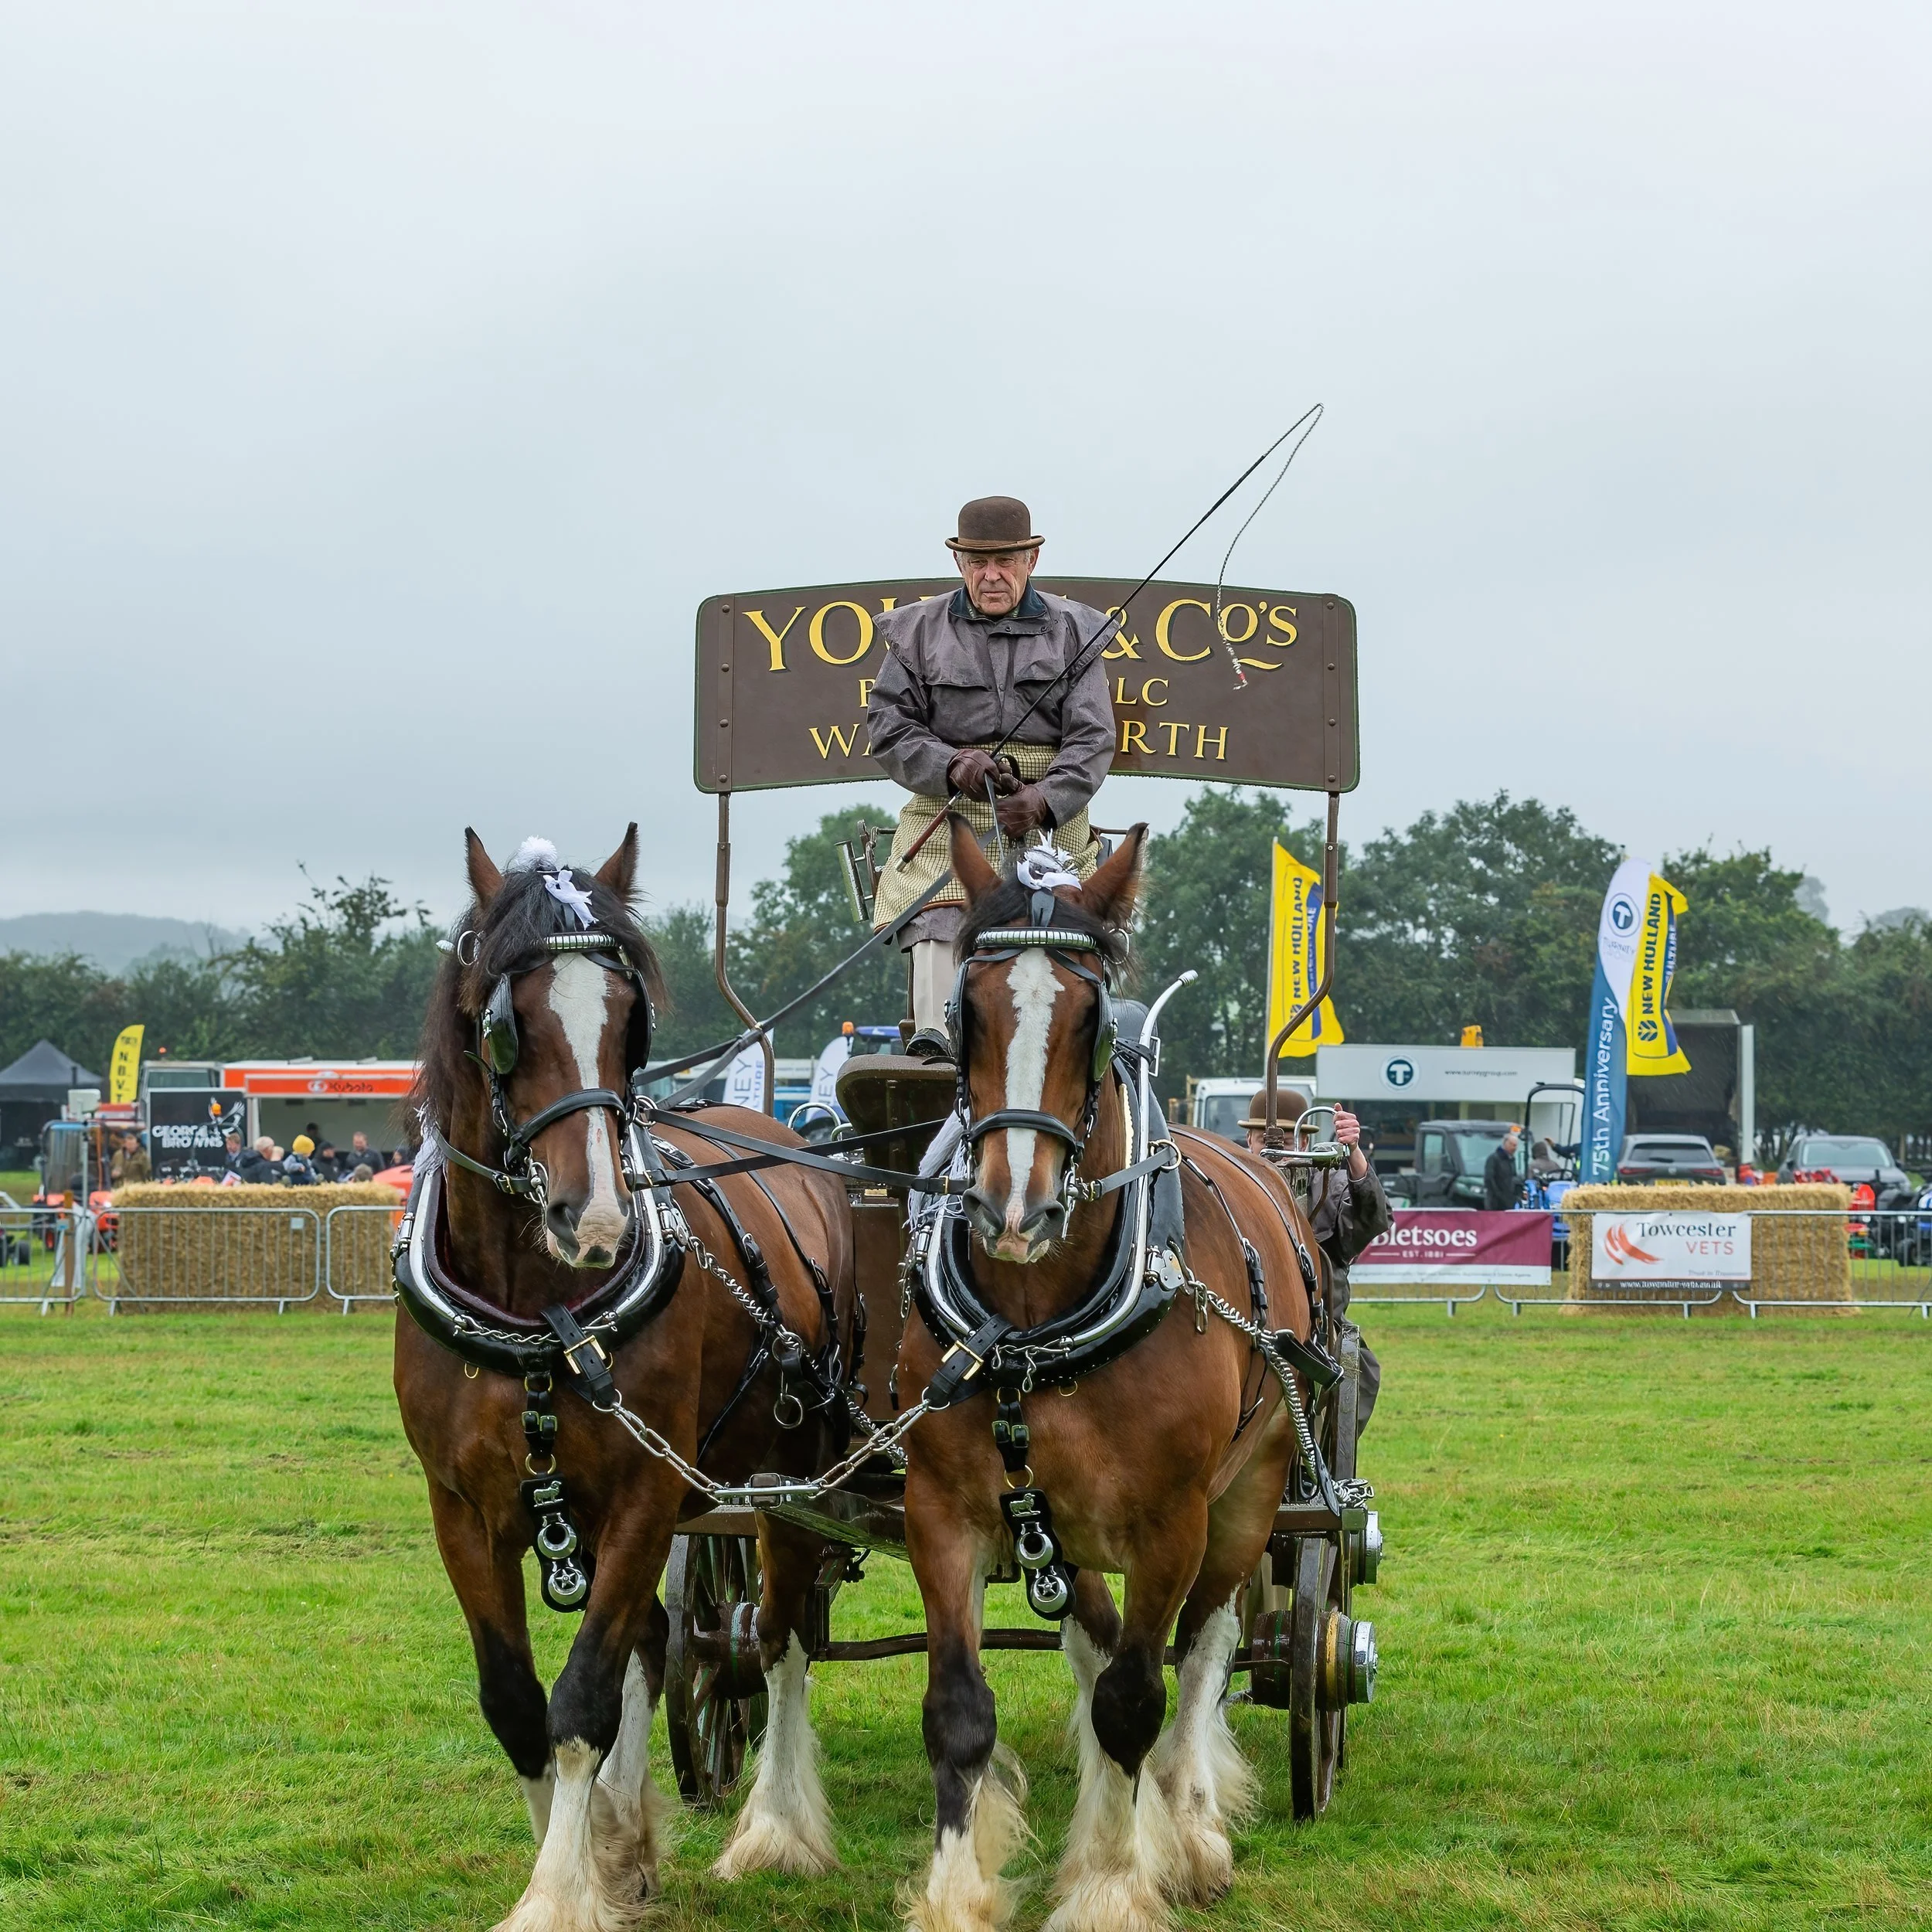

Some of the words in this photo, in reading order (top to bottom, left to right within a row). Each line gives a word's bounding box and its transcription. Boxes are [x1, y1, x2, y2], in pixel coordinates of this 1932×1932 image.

[1642, 975, 1654, 1015] NEW
[1593, 996, 1618, 1122] Anniversary
[1592, 1128, 1611, 1176] 75th
[1636, 1223, 1736, 1237] Towcester
[1686, 1240, 1734, 1255] VETS
